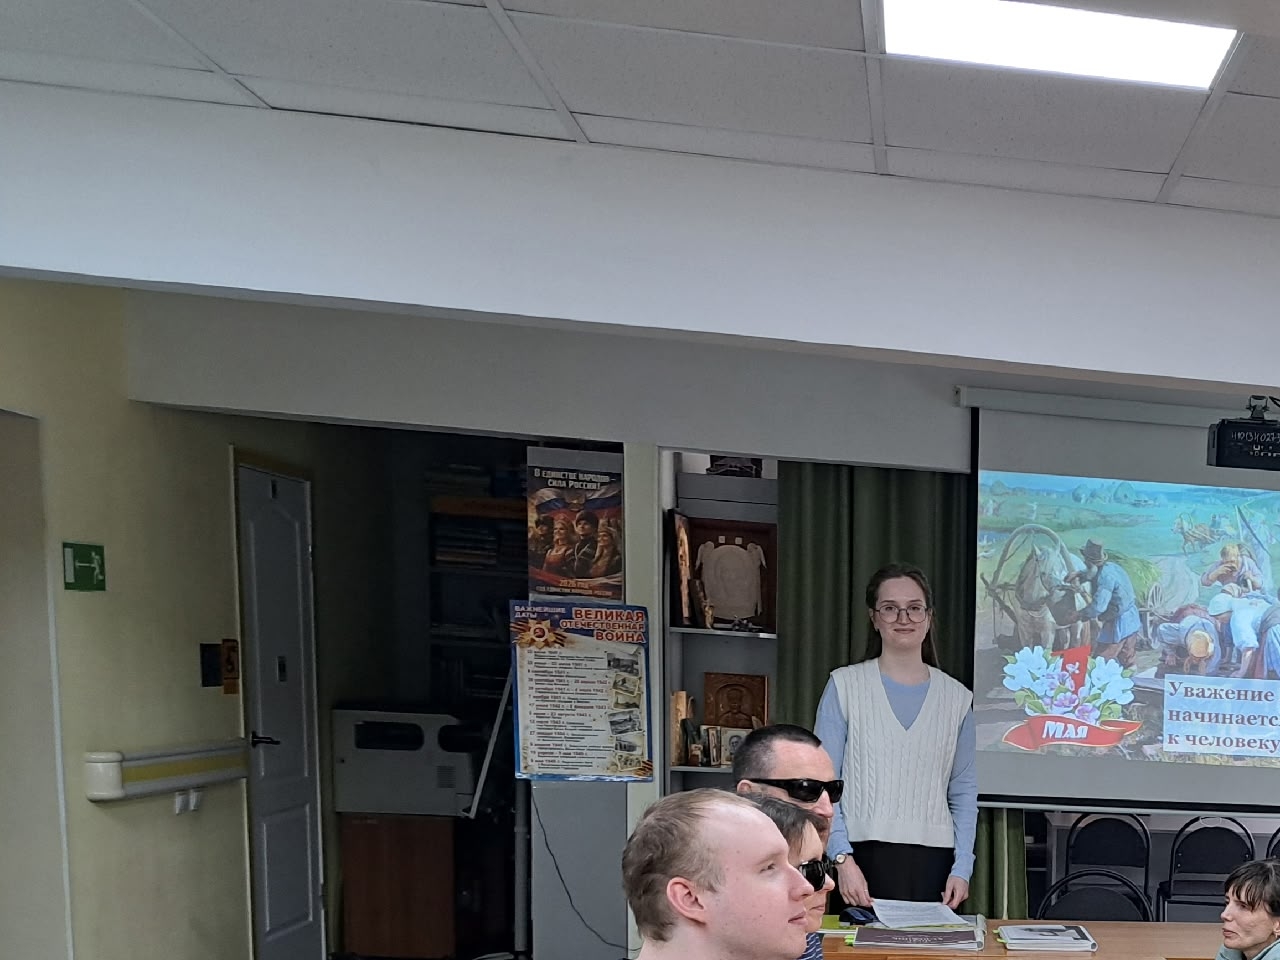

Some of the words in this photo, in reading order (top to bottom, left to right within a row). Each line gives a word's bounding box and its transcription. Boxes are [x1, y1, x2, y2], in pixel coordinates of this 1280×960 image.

[548, 479, 566, 488] СИЛА
[573, 608, 645, 622] ВЕЛИКАЯ
[560, 619, 645, 632] ОТЕЧЕСТВЕННАЯ
[1168, 681, 1275, 702] Уважение
[1167, 733, 1179, 745] к
